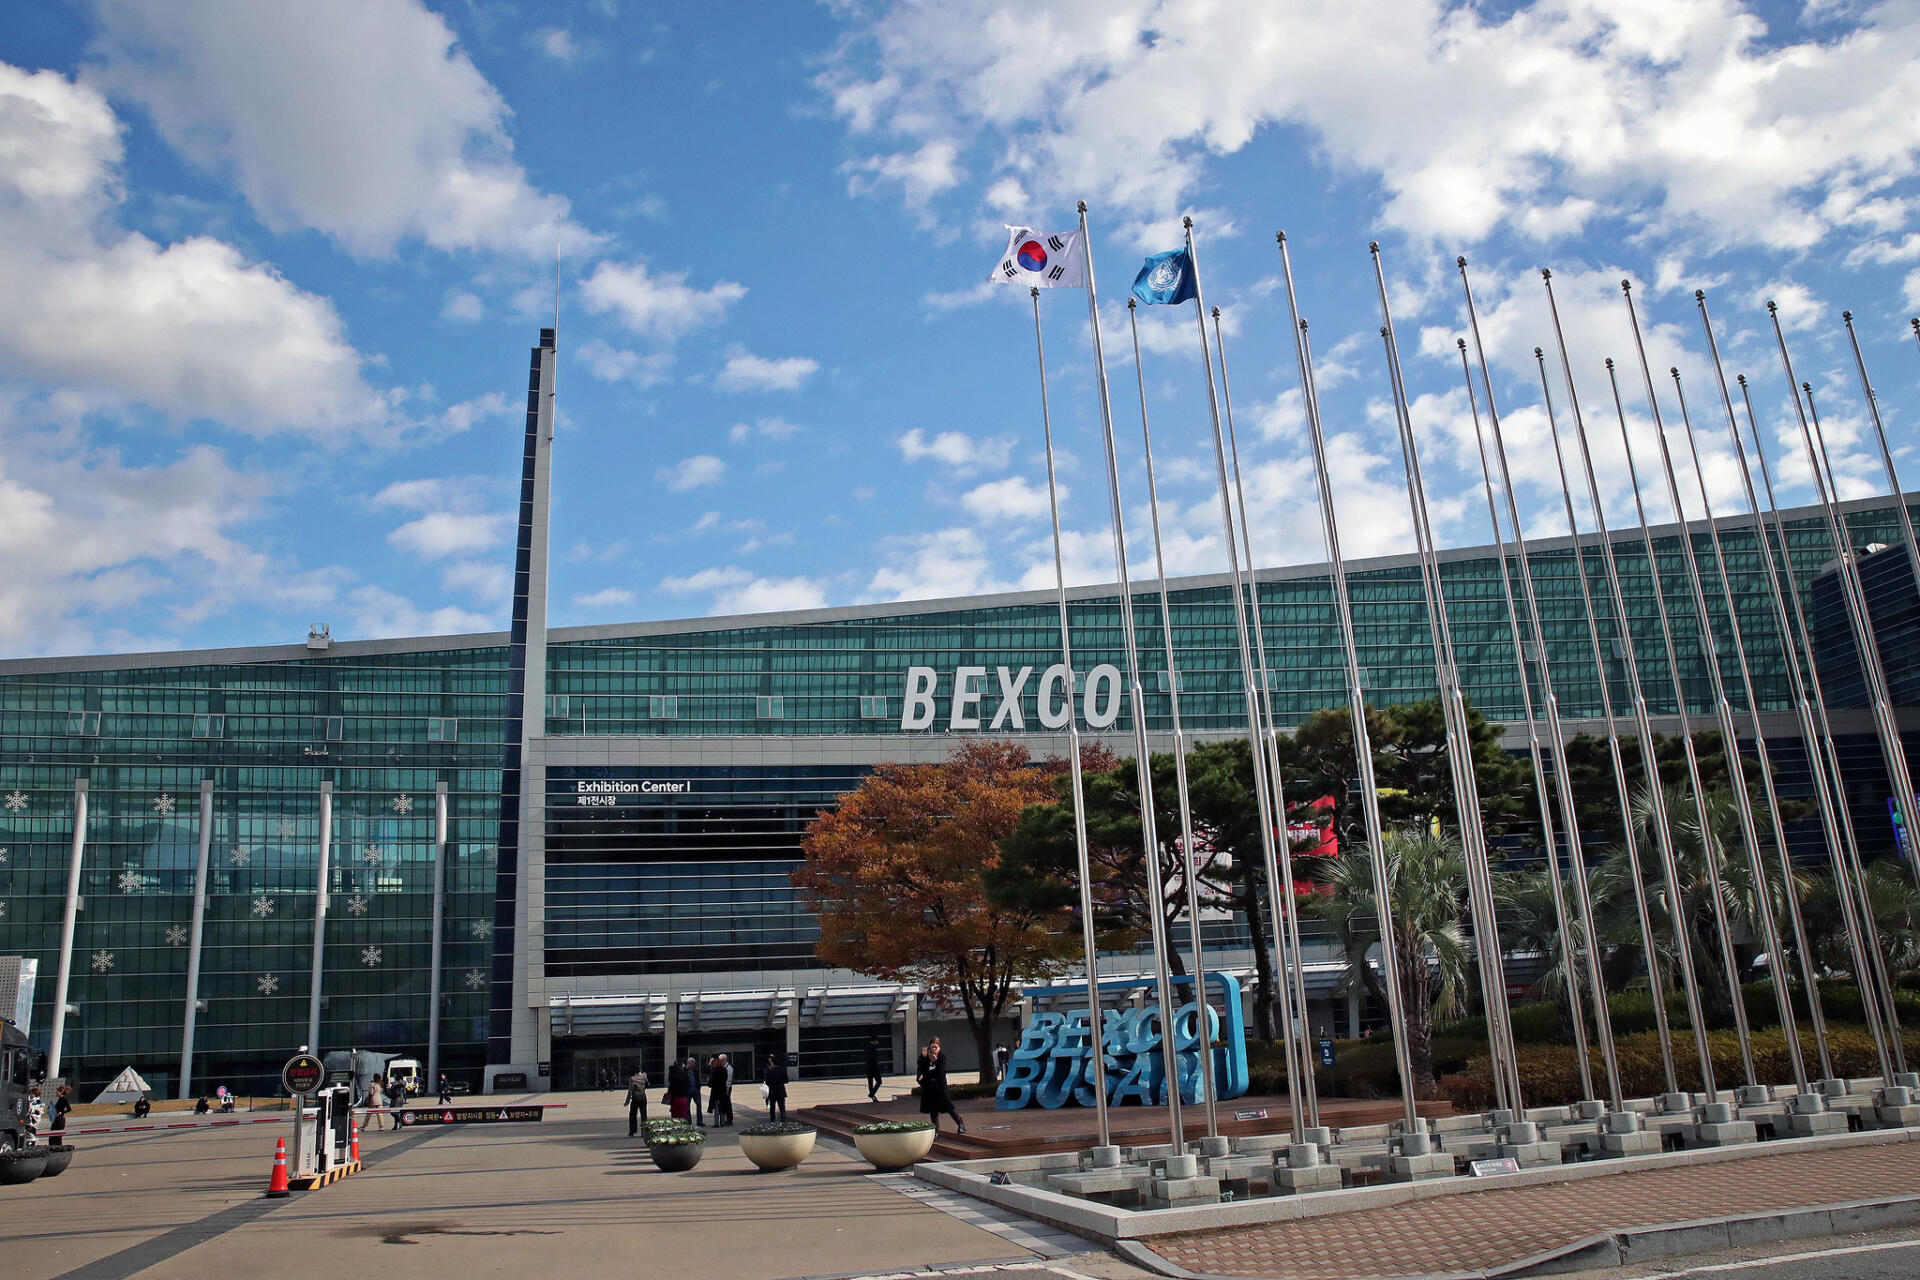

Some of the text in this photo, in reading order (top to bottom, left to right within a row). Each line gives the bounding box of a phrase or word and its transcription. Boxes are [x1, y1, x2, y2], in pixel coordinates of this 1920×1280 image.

[901, 663, 1122, 729] BEXCO
[577, 780, 639, 793] Exhibition
[641, 780, 684, 793] Center
[577, 795, 617, 806] 제1전시장
[1013, 1002, 1220, 1060] BEXCO
[995, 1052, 1217, 1111] BUSAN
